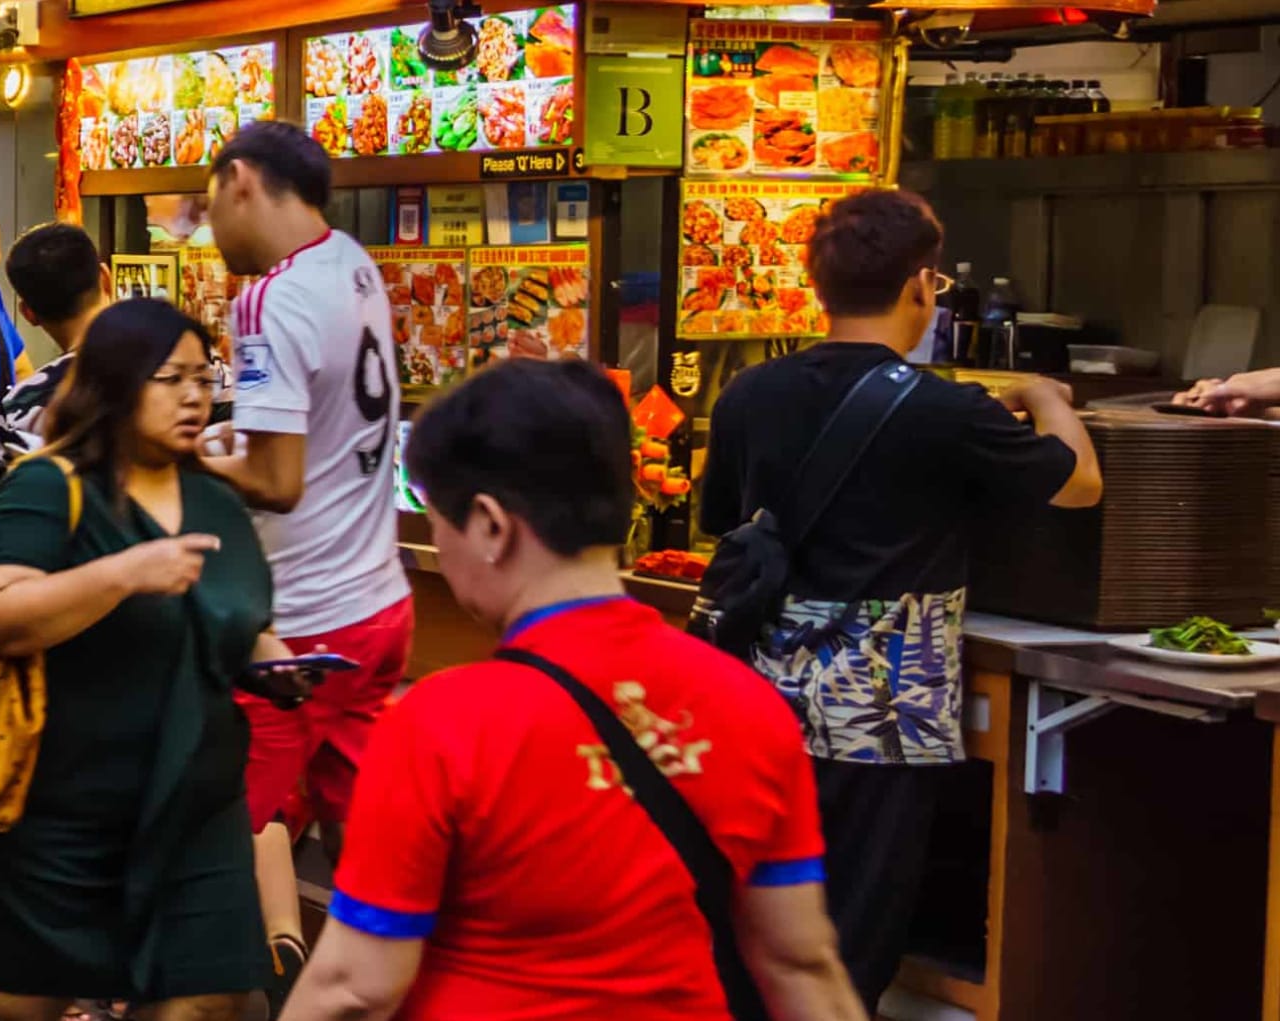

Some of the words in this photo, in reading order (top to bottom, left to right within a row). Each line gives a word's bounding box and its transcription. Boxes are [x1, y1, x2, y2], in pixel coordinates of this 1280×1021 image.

[616, 86, 653, 137] B
[483, 157, 515, 173] Please
[530, 153, 553, 170] Here
[353, 323, 393, 475] 9
